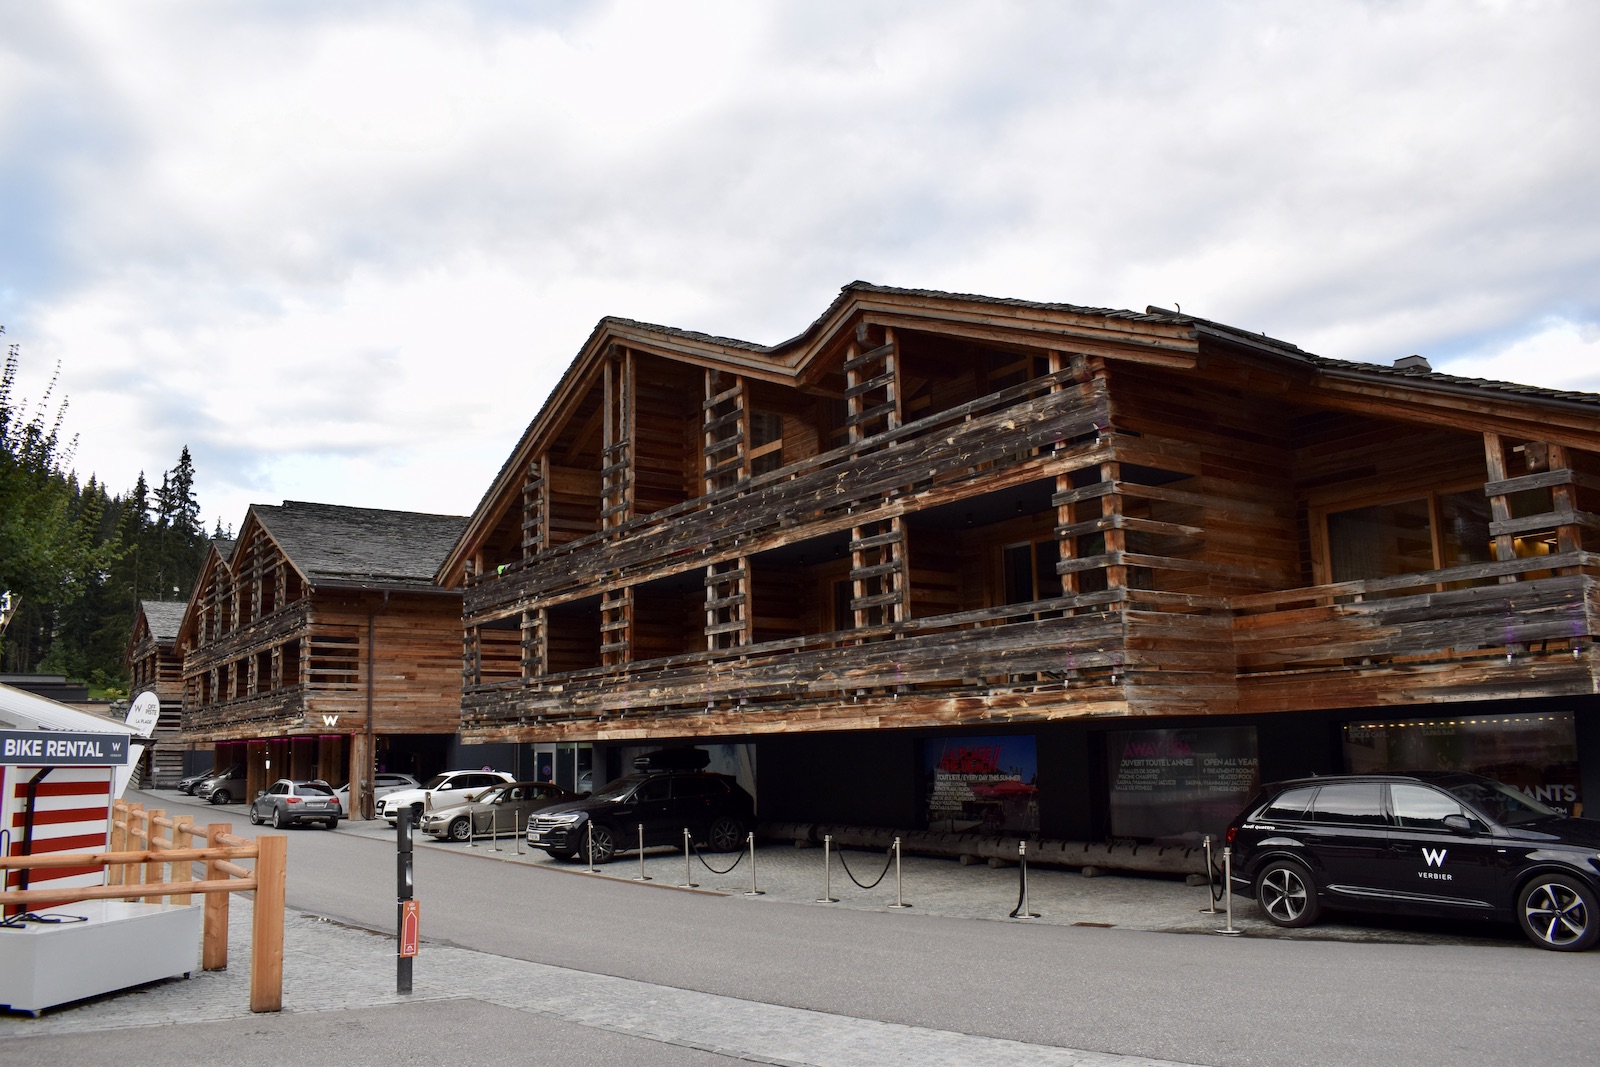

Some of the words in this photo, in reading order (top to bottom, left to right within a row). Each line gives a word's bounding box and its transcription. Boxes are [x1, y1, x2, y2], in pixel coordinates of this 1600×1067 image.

[134, 703, 143, 712] W
[322, 714, 339, 727] W
[4, 738, 43, 757] BIKE
[46, 740, 104, 758] RENTAL
[112, 742, 122, 752] W
[1146, 758, 1167, 766] TOUTE
[1204, 759, 1224, 767] OPEN
[1224, 758, 1238, 766] ALL
[1238, 758, 1259, 766] YEAR
[1421, 847, 1448, 868] W
[1417, 871, 1453, 881] VERBIER
